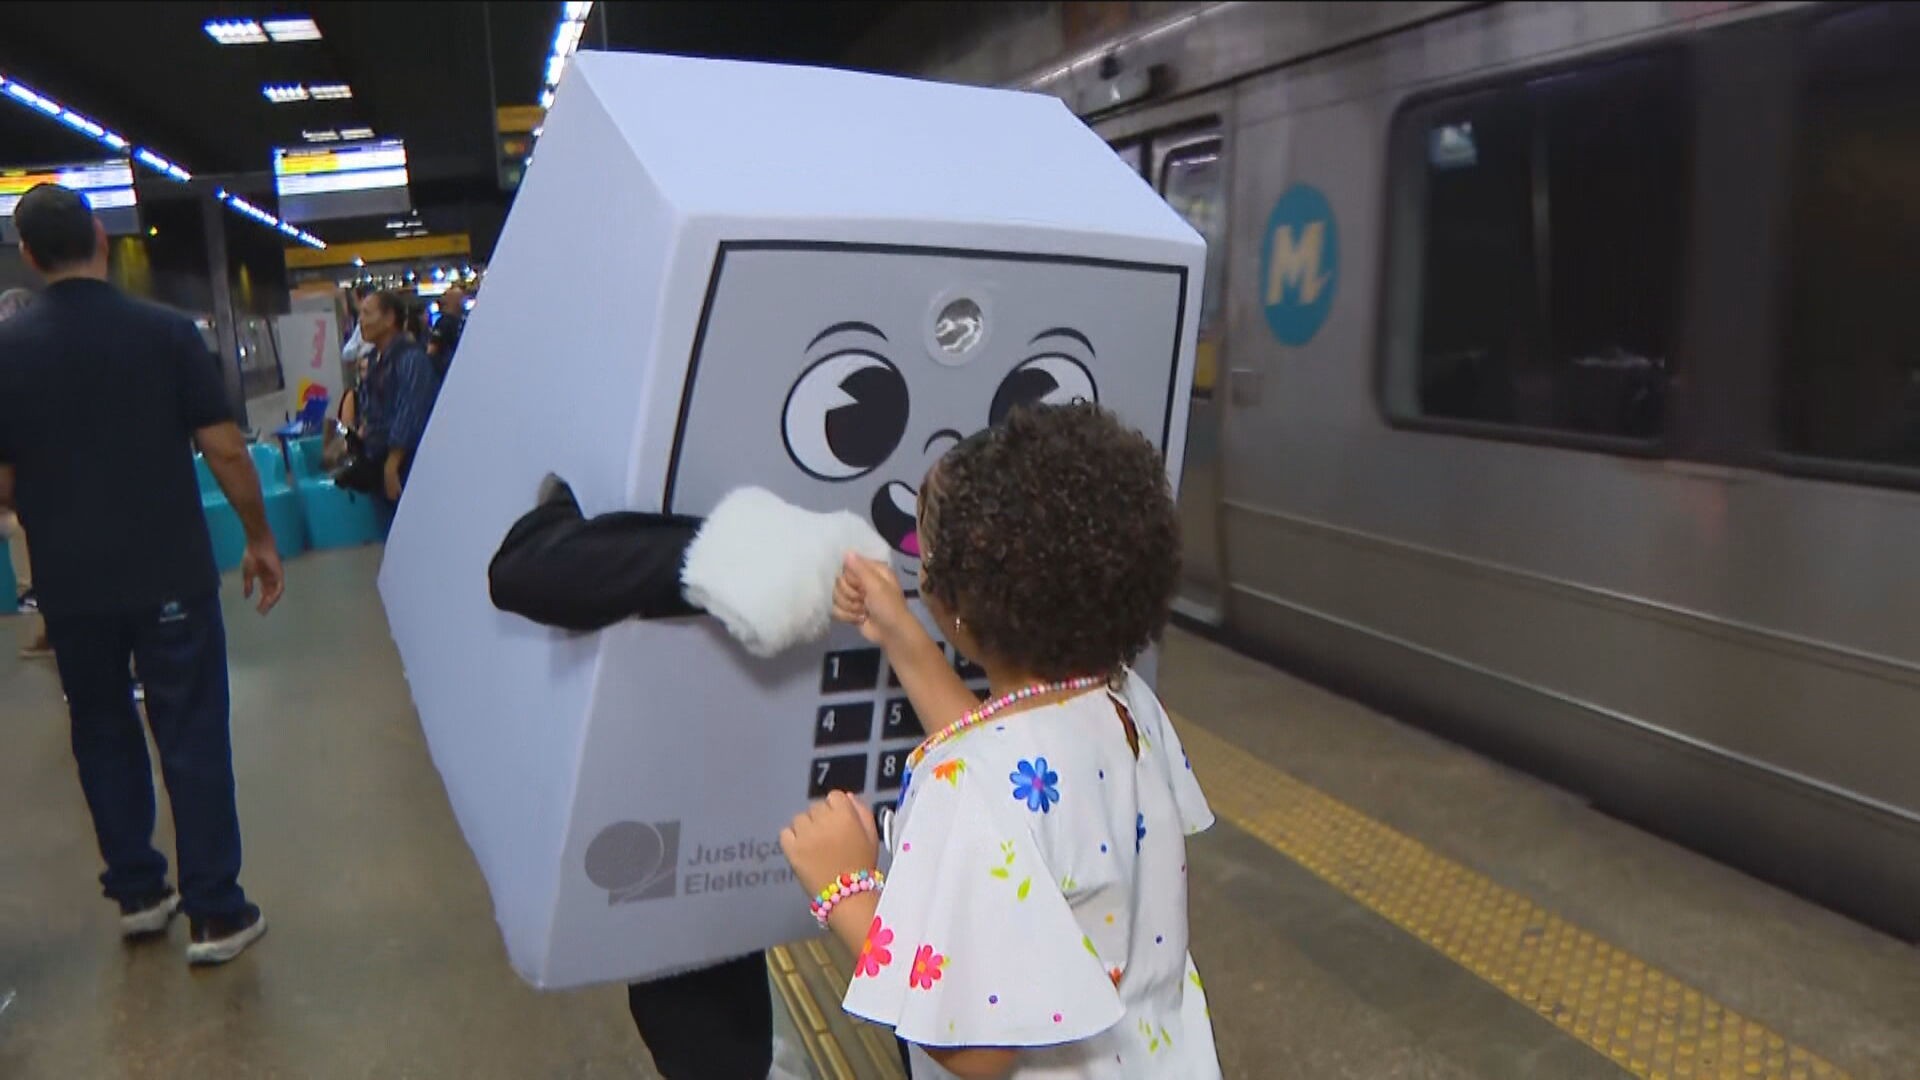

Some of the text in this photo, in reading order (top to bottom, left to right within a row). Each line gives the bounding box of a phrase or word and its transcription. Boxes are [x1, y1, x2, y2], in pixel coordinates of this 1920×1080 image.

[1266, 221, 1330, 306] M
[830, 657, 841, 679] 1
[822, 704, 902, 732] 4 5
[817, 755, 896, 785] 7 8
[687, 839, 785, 867] Justiça
